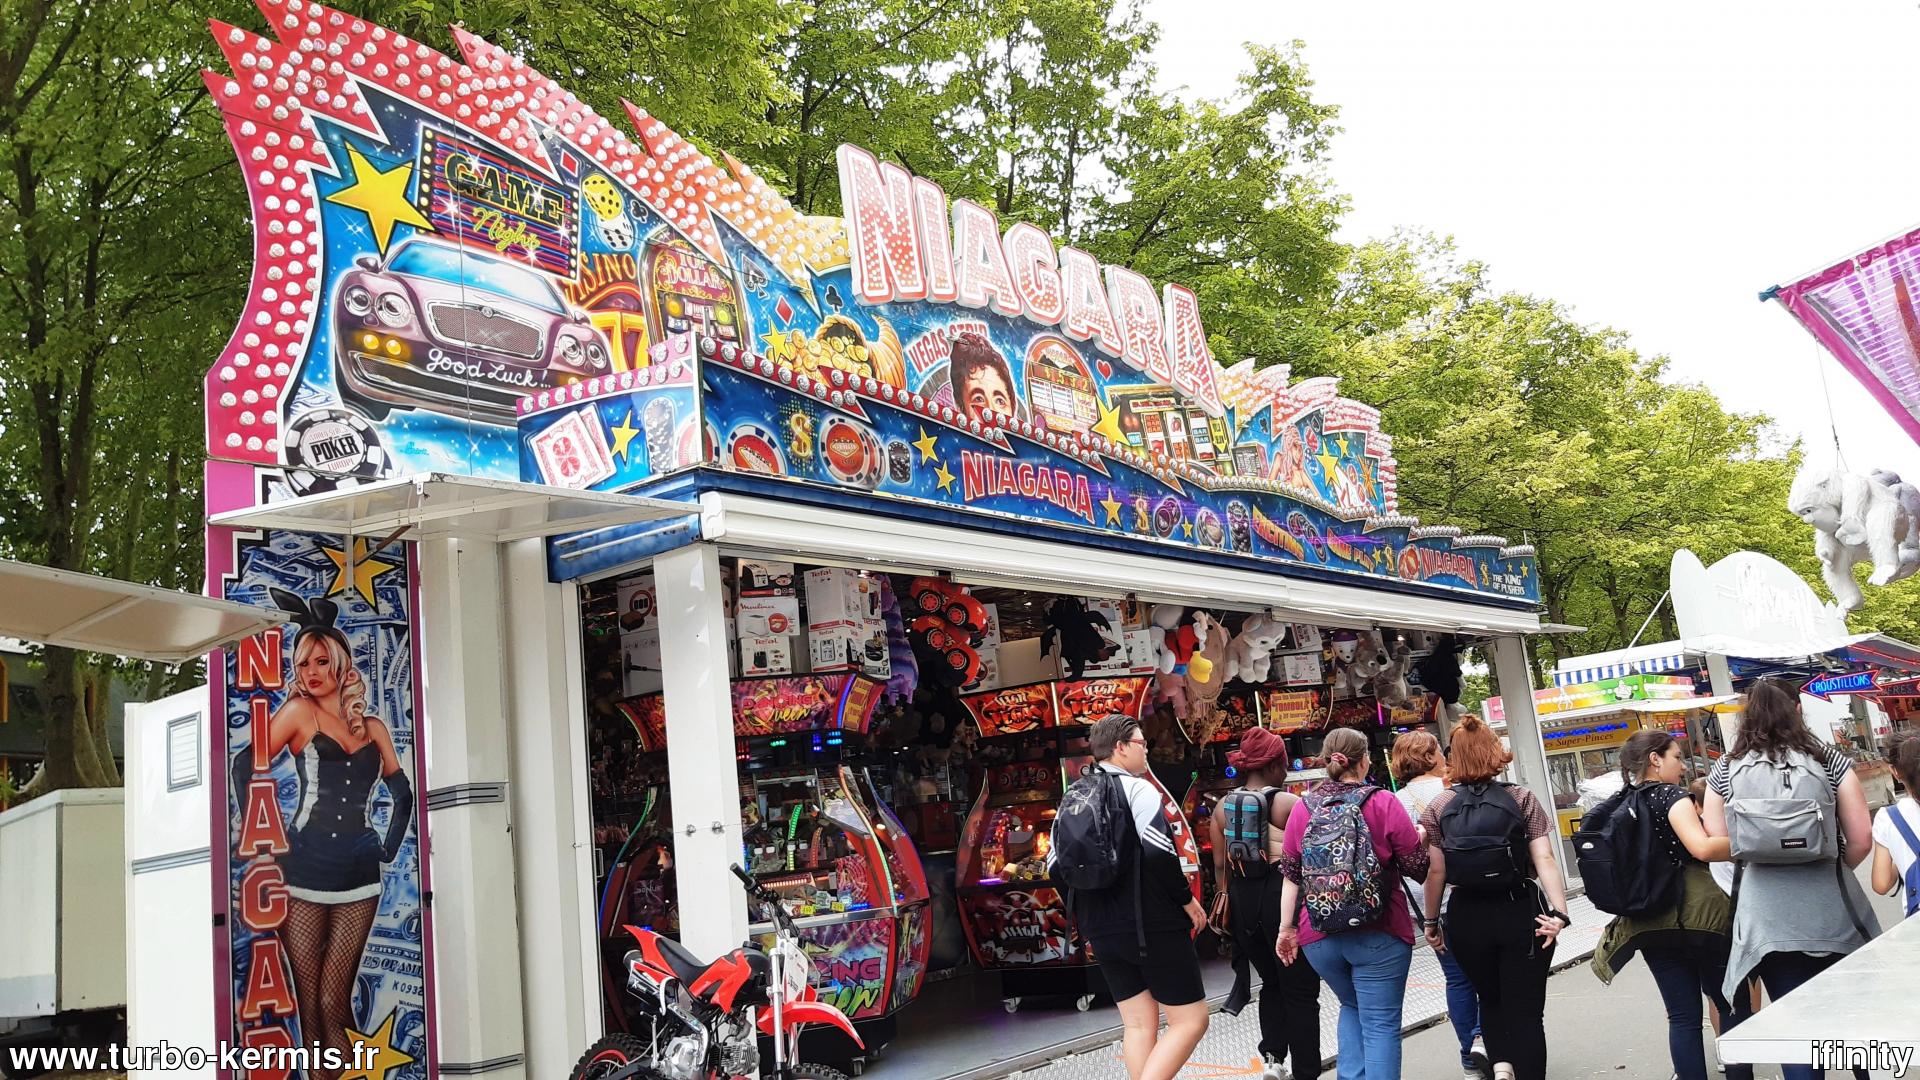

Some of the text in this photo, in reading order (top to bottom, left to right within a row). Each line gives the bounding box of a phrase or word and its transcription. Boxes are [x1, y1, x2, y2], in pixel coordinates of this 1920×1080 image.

[445, 153, 565, 229] GAME
[472, 207, 540, 251] Night
[666, 262, 724, 291] DOLLAR
[836, 143, 1224, 418] NIAGARA
[426, 348, 485, 378] good
[907, 328, 950, 374] VEGAS
[310, 435, 360, 463] POKER
[962, 449, 1095, 524] NIAGARA
[810, 568, 833, 577] Tefal
[1419, 546, 1479, 591] NIAGARA
[1492, 573, 1502, 583] THE
[1492, 582, 1501, 591] OF
[754, 637, 779, 646] Tefal
[1809, 674, 1871, 693] CROUSTILLONS
[1556, 733, 1615, 748] Super-Pinces
